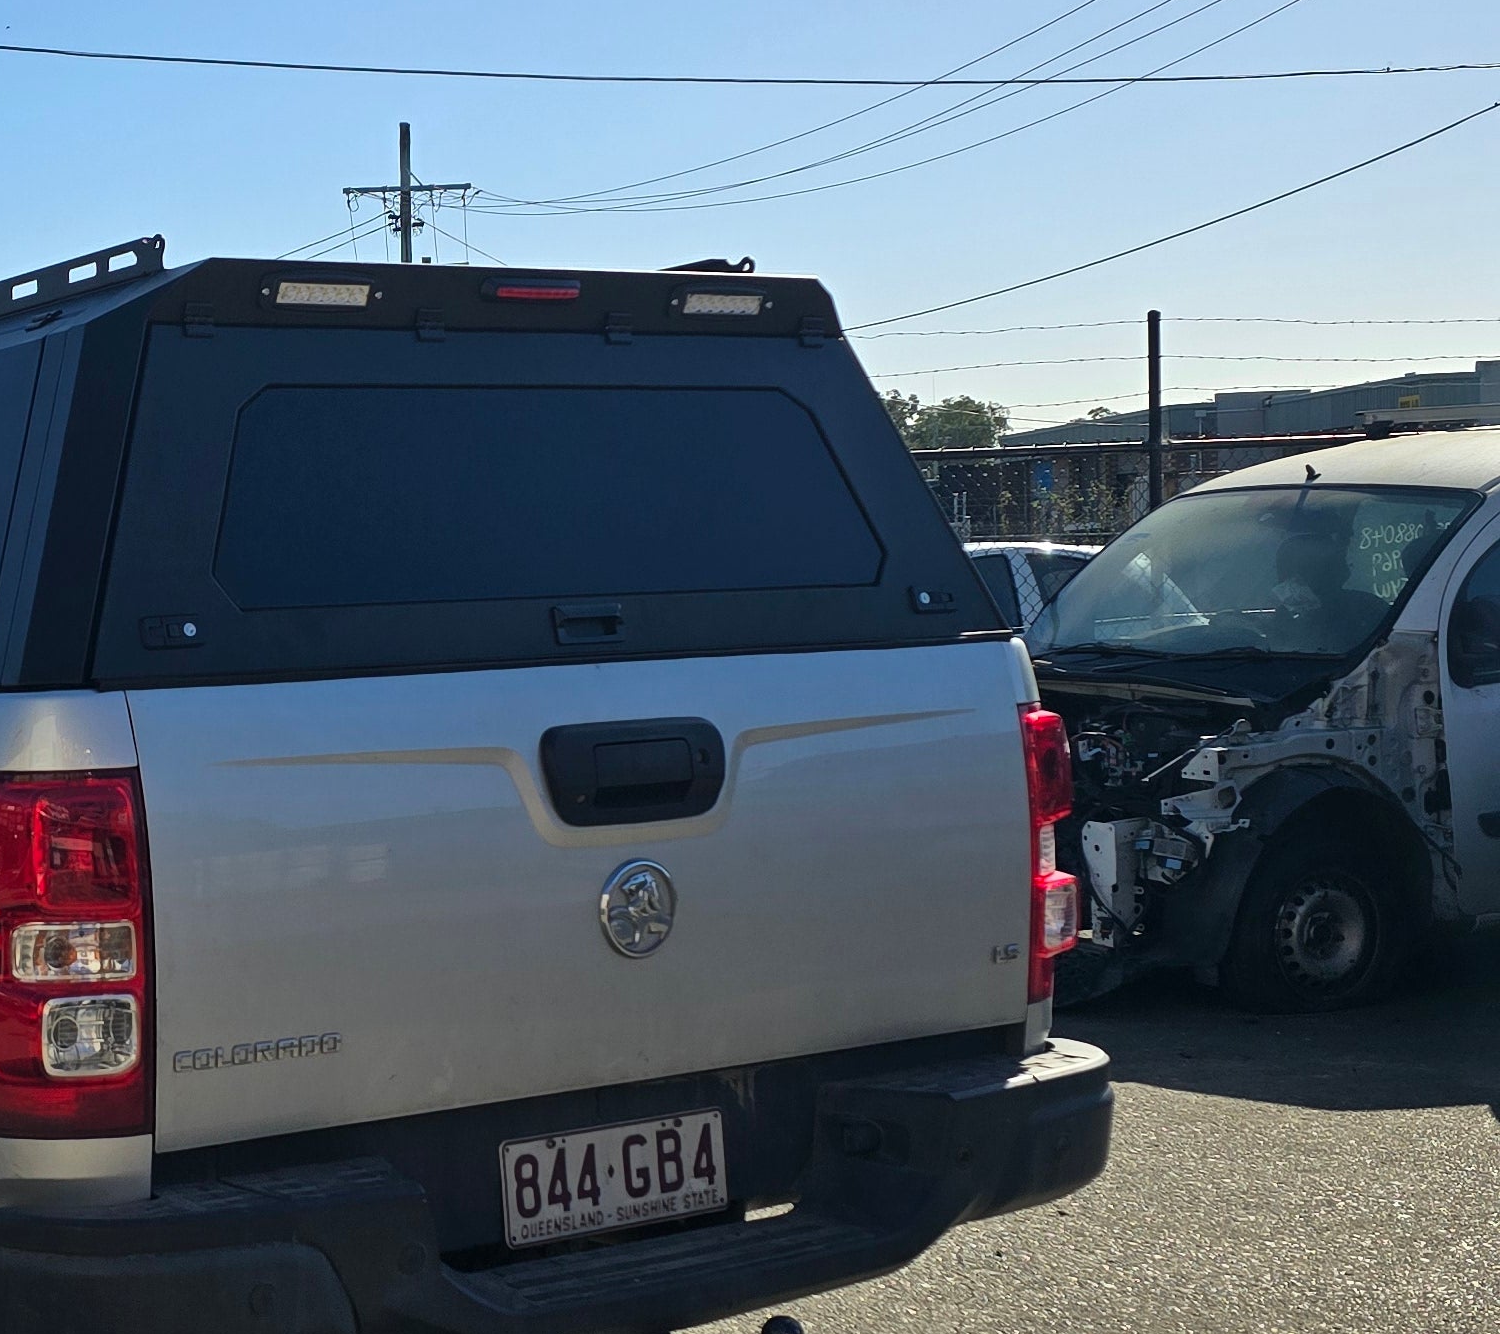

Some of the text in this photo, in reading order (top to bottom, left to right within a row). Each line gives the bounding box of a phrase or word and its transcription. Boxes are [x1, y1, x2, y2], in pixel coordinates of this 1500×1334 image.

[172, 1031, 343, 1074] COLORADO
[513, 1122, 717, 1219] 844 GB4
[520, 1211, 605, 1240] QUEENSLAND
[616, 1196, 677, 1222] SUNSHINE
[683, 1188, 720, 1210] STATE
